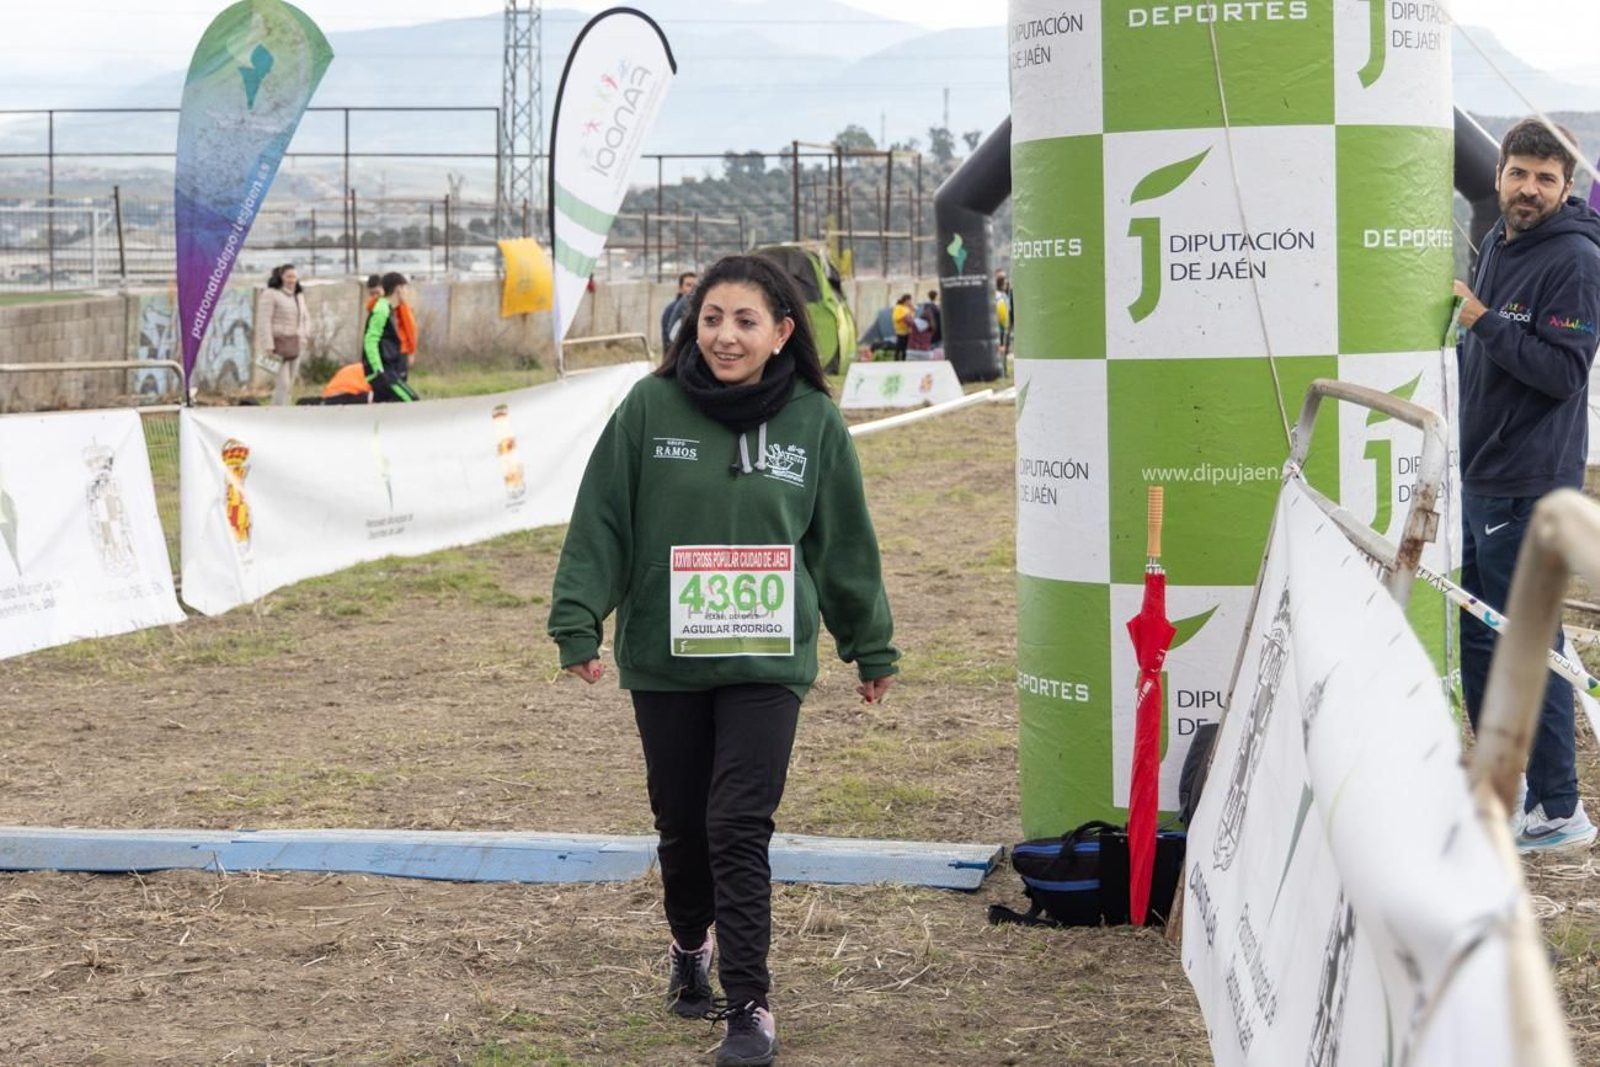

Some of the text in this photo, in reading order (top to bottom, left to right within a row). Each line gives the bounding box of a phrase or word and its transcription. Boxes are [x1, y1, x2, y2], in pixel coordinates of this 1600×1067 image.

[1129, 1, 1308, 28] DEPORTES
[1392, 30, 1413, 48] DE
[1170, 228, 1314, 253] DIPUTACIÓN
[1170, 258, 1266, 281] DE JAÉN
[656, 446, 697, 458] RAMOS
[1142, 463, 1283, 485] www.dipujaen.
[693, 551, 712, 568] CROSS
[713, 551, 739, 568] POPULAR
[740, 551, 762, 568] CIUDAD
[763, 551, 772, 568] DE
[679, 573, 784, 611] 4360
[682, 624, 783, 634] AGUILAR RODRIGO
